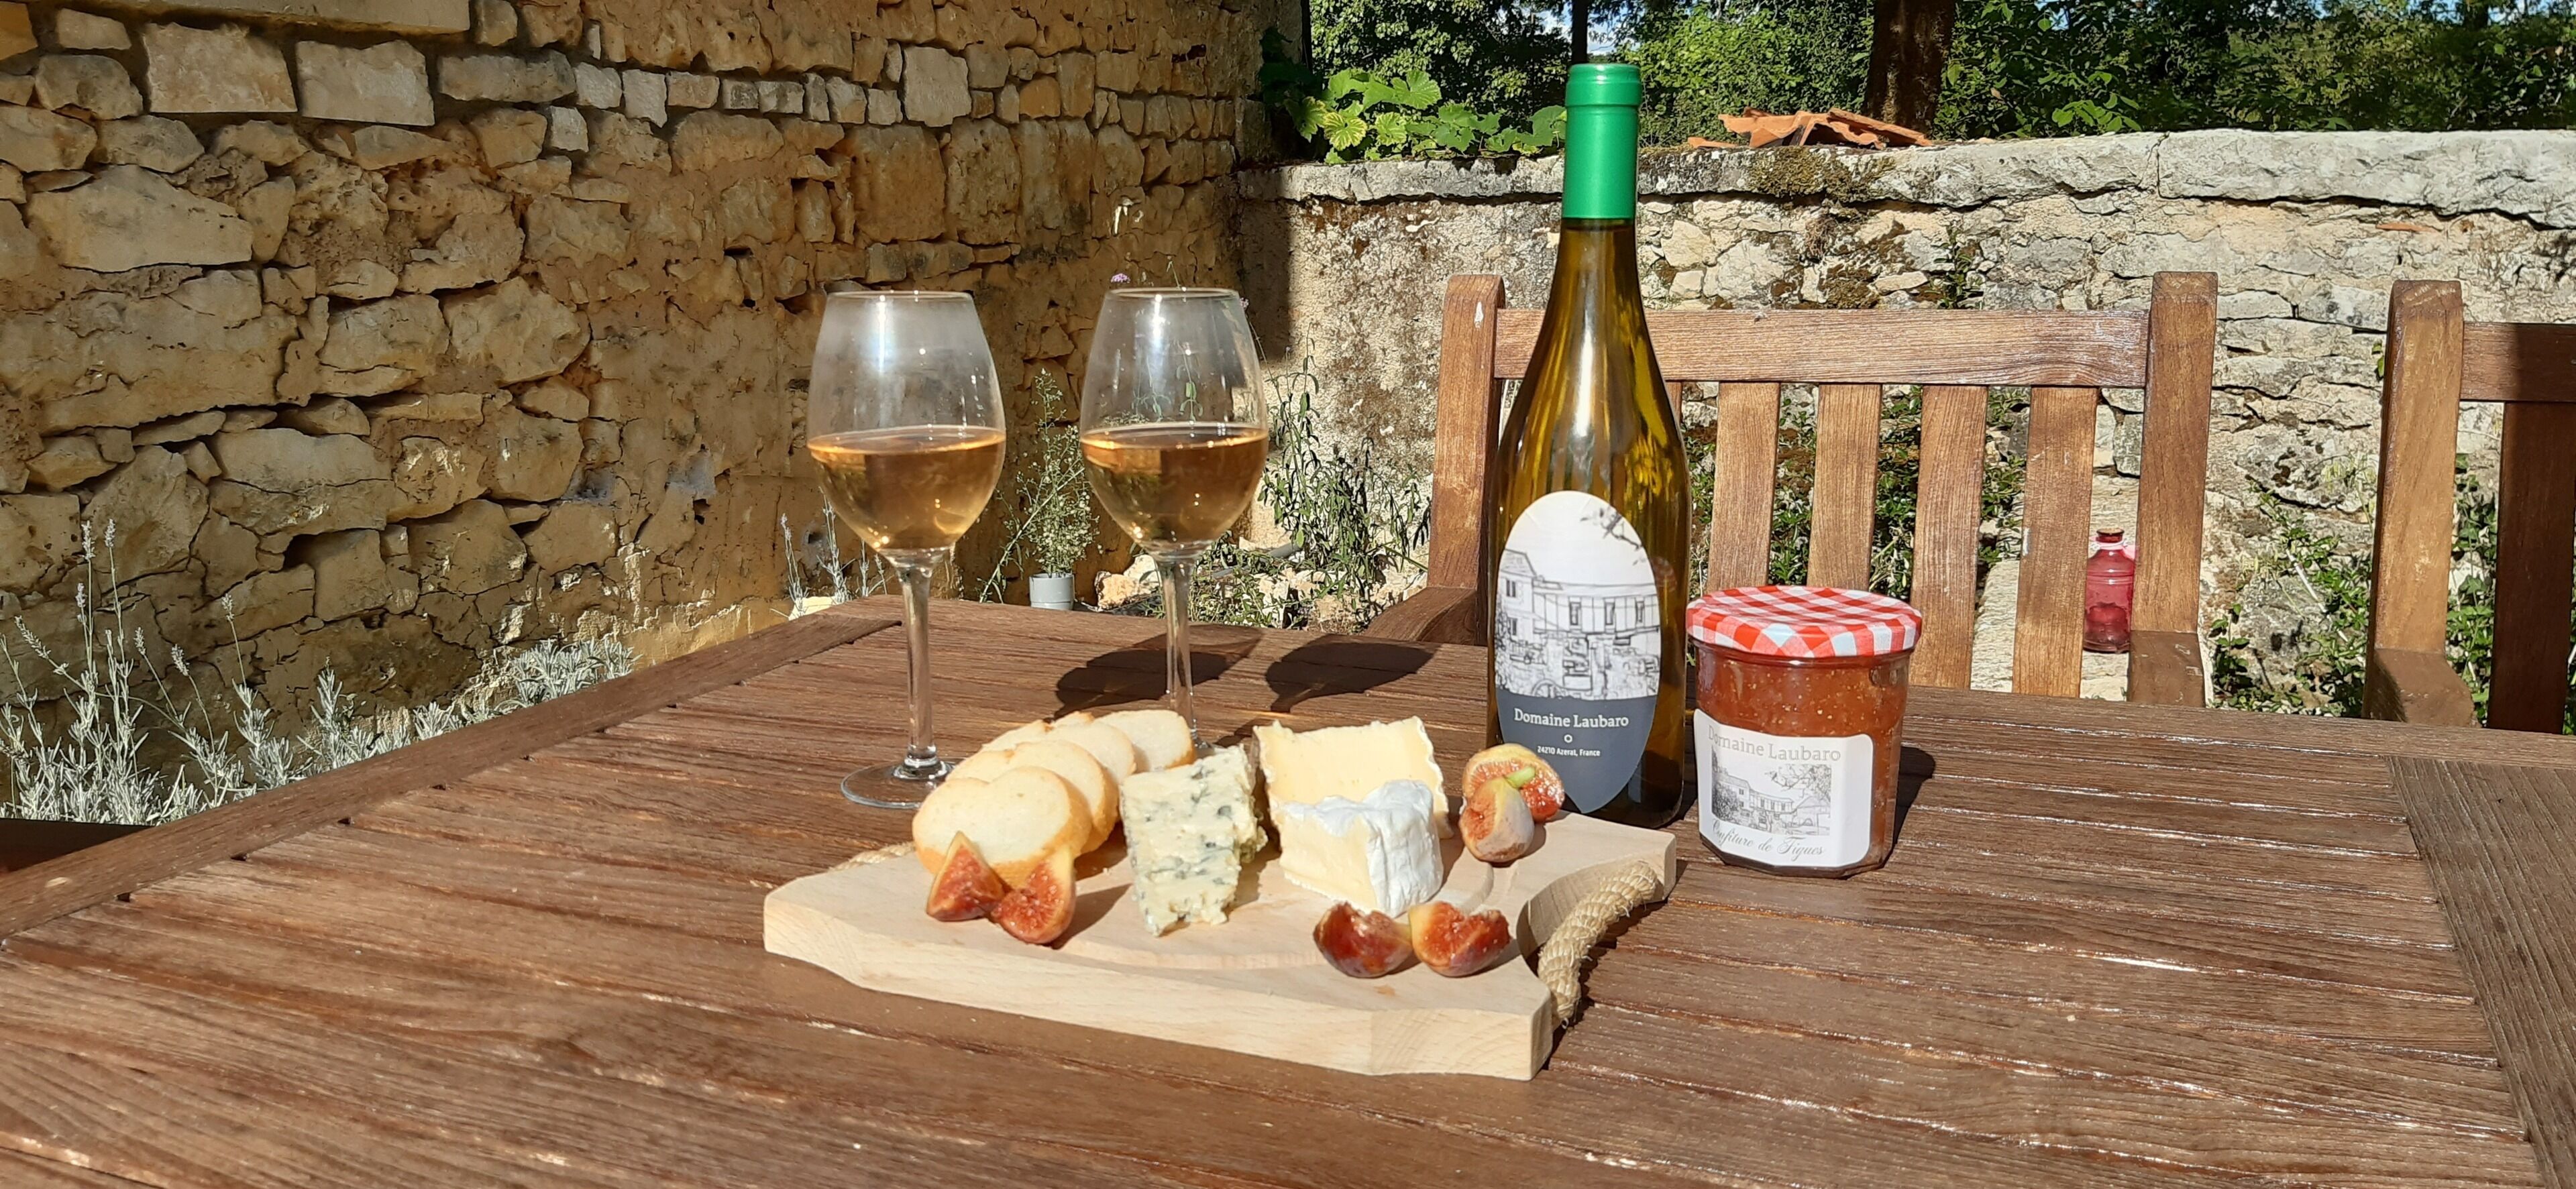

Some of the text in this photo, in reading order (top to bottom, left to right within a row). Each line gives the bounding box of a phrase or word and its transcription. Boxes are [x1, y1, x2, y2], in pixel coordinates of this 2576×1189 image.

[1513, 707, 1629, 728] Domaine Laubaro
[1537, 745, 1556, 755] 24210
[1579, 748, 1601, 756] France
[1708, 724, 1841, 762] Domaine Laubaro
[1758, 837, 1773, 852] de
[1778, 836, 1824, 862] Figues
